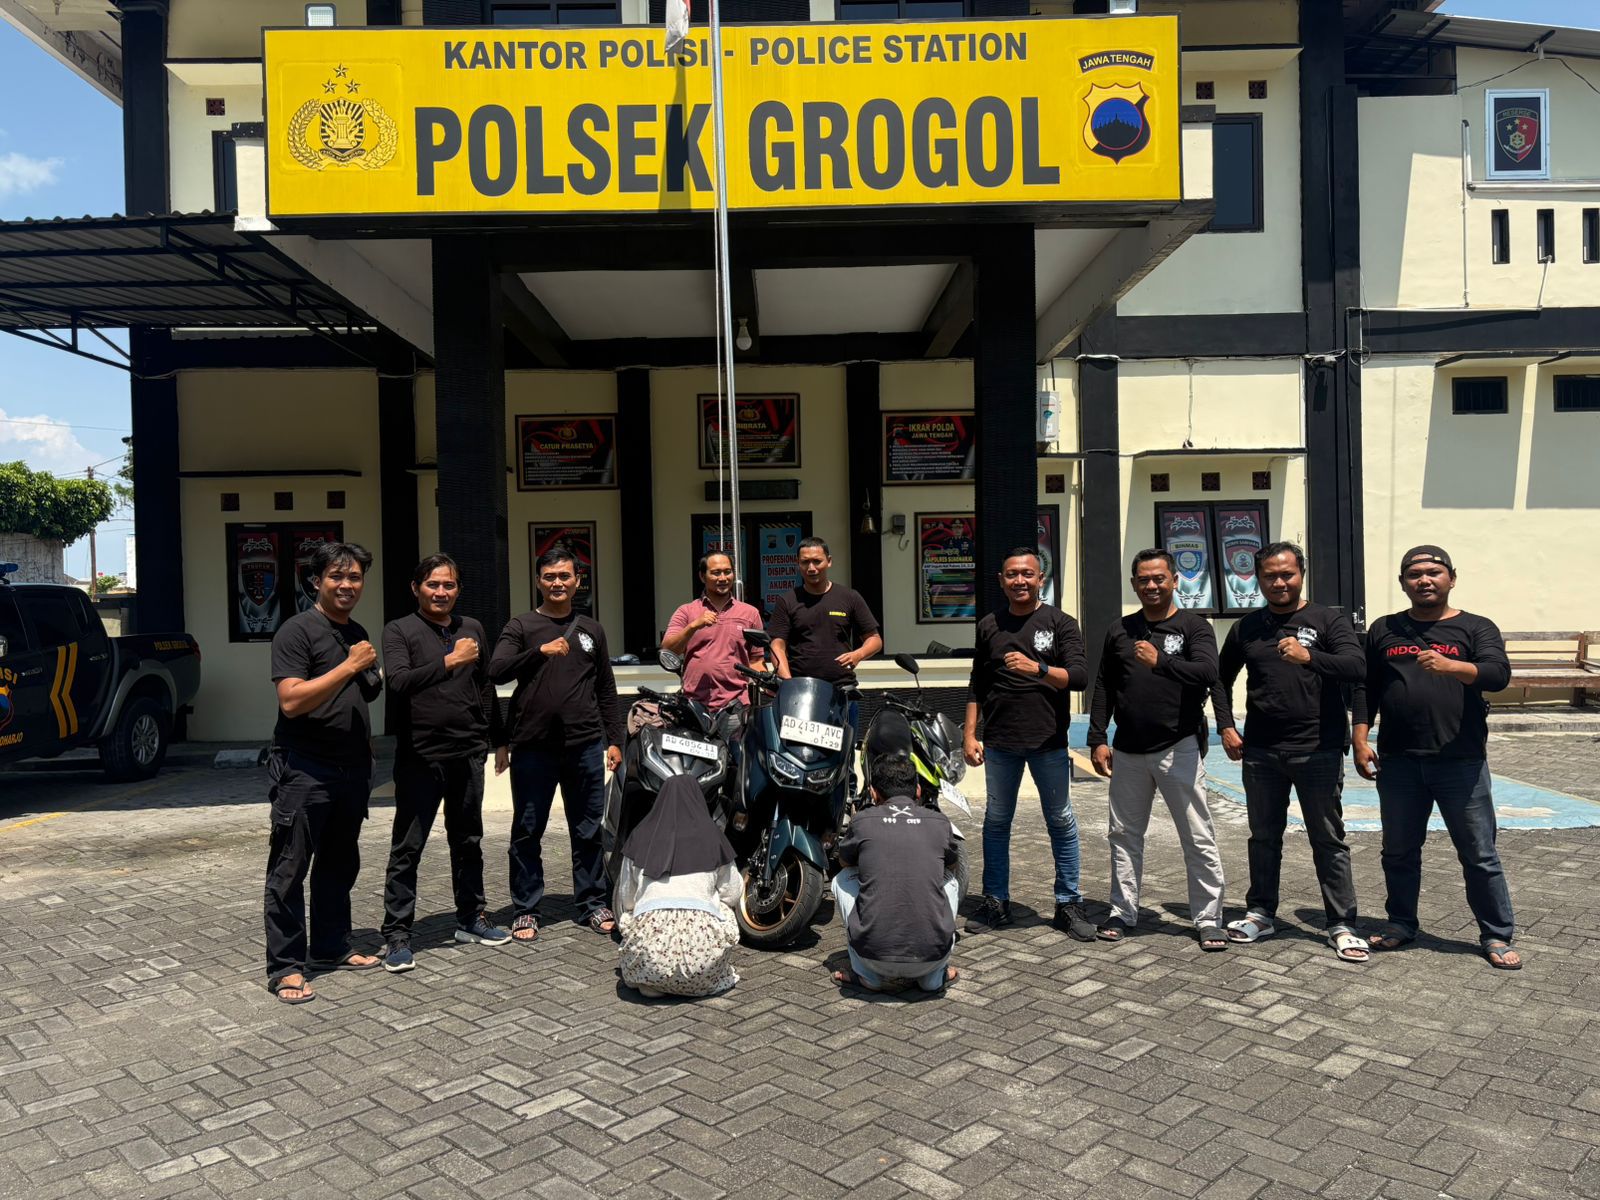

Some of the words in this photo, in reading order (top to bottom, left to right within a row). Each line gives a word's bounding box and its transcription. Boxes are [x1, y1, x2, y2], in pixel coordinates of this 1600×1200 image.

[444, 41, 587, 69] KANTOR
[599, 38, 709, 68] POLISI
[751, 35, 872, 65] POLICE
[883, 32, 1027, 63] STATION
[1082, 56, 1110, 69] JAWA
[1110, 54, 1151, 67] TENGAH
[415, 103, 714, 196] POLSEK
[748, 96, 1060, 192] GROGOL
[909, 424, 931, 432] IKRAR
[932, 423, 955, 432] POLDA
[762, 554, 798, 564] PROFESIONA
[767, 566, 797, 576] DISIPLIN
[769, 580, 796, 590] AKURAT
[1387, 643, 1460, 656] INDOSIA
[784, 717, 796, 729] AD
[798, 720, 820, 733] 4131
